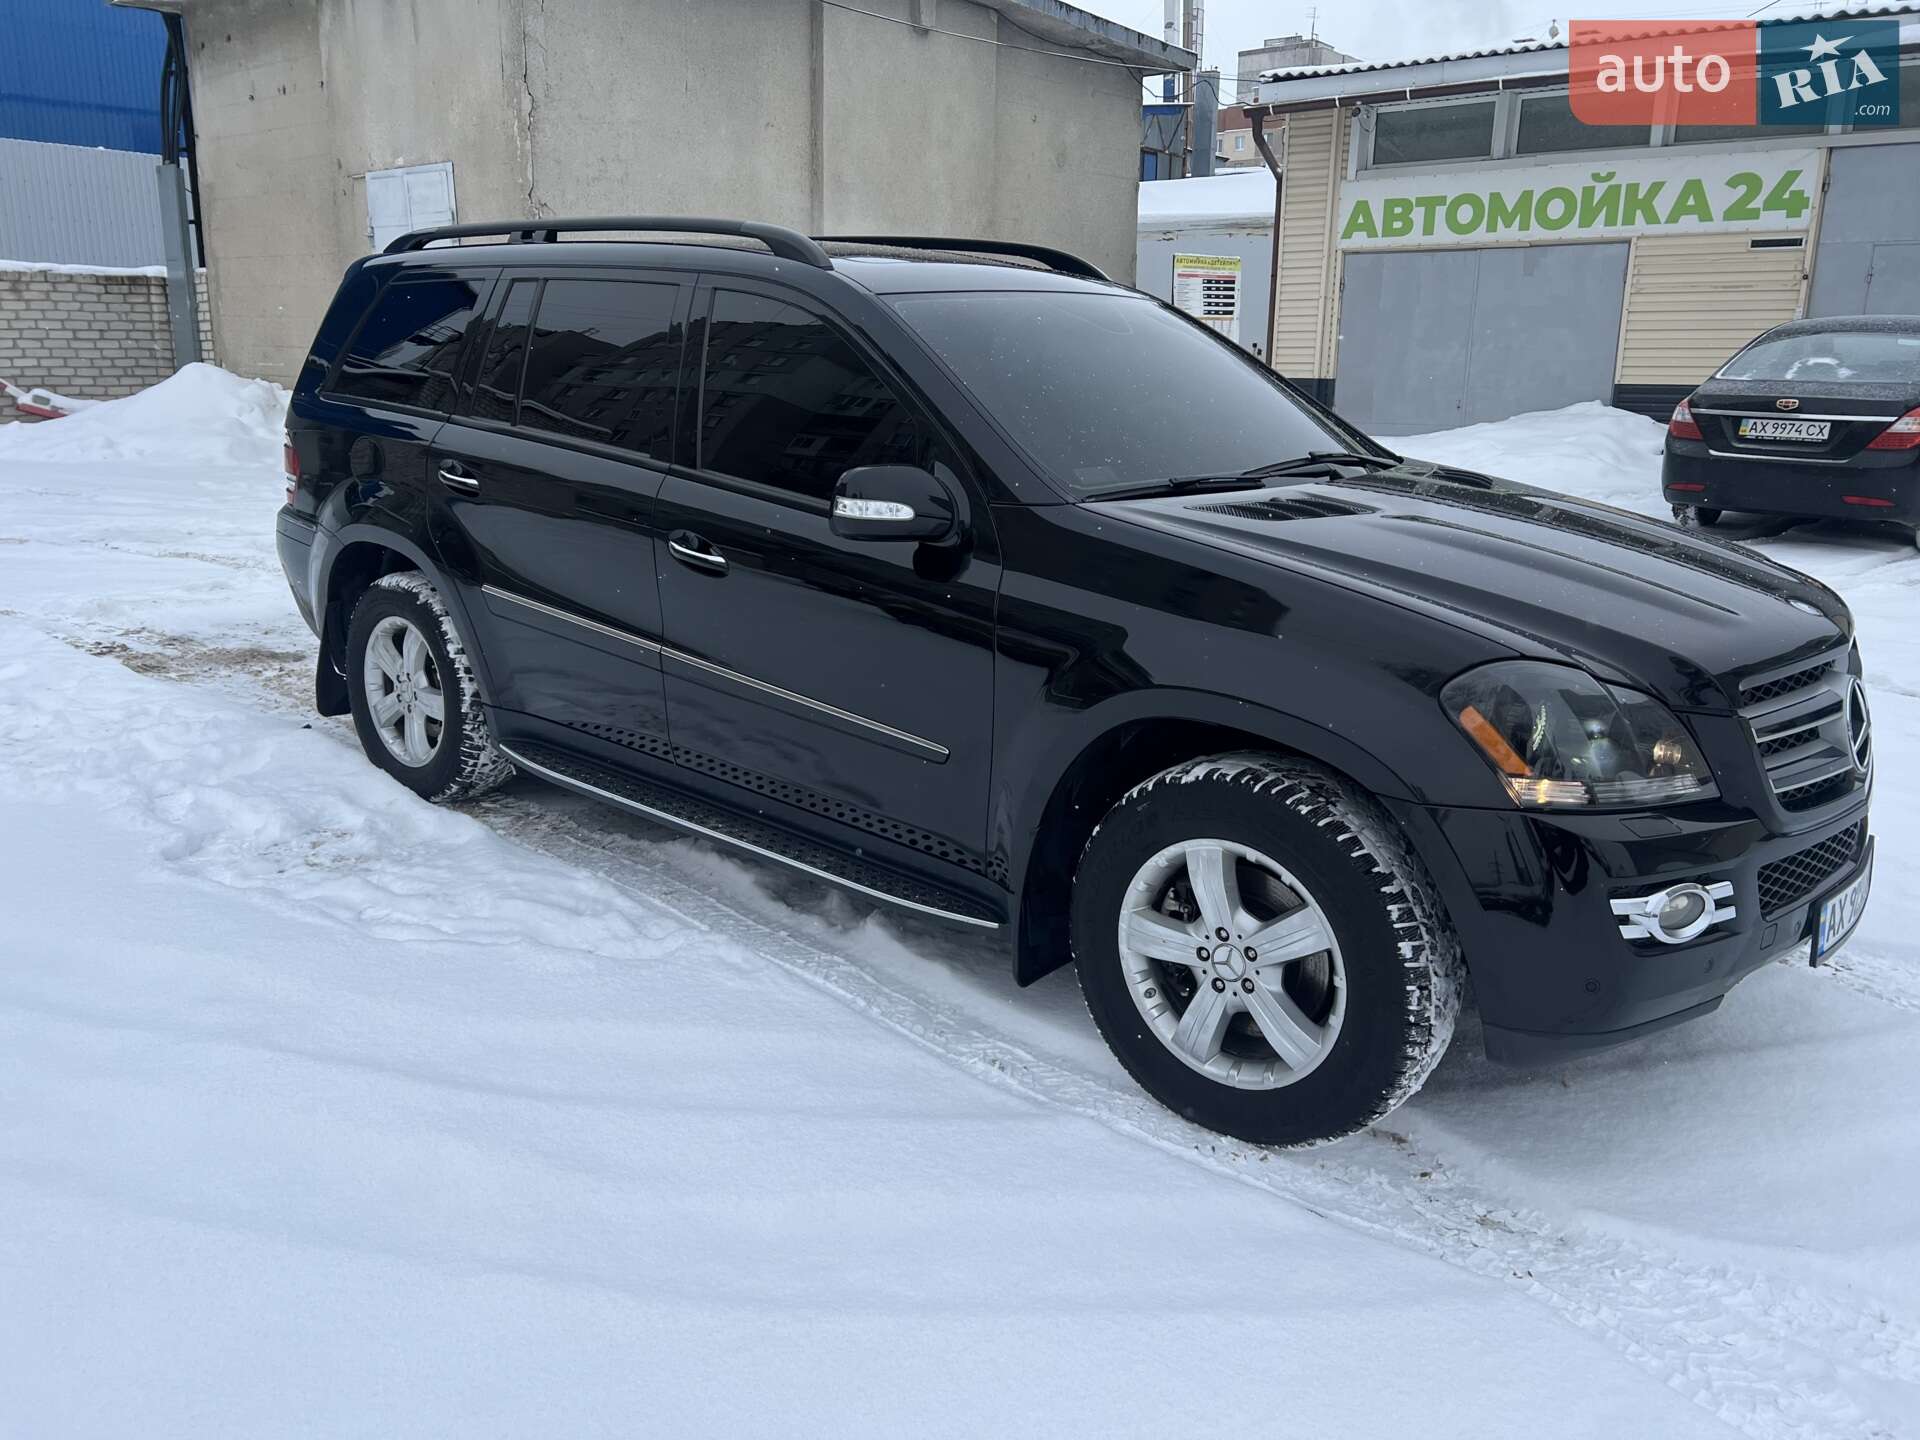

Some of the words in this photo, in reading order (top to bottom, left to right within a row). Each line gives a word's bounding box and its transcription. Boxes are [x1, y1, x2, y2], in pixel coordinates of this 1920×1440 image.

[1339, 171, 1715, 240] АВТОМОЙКА
[1722, 169, 1811, 222] 24
[1749, 421, 1769, 434] AX
[1771, 422, 1803, 436] 9974
[1806, 424, 1828, 437] CX
[1826, 893, 1848, 943] AX
